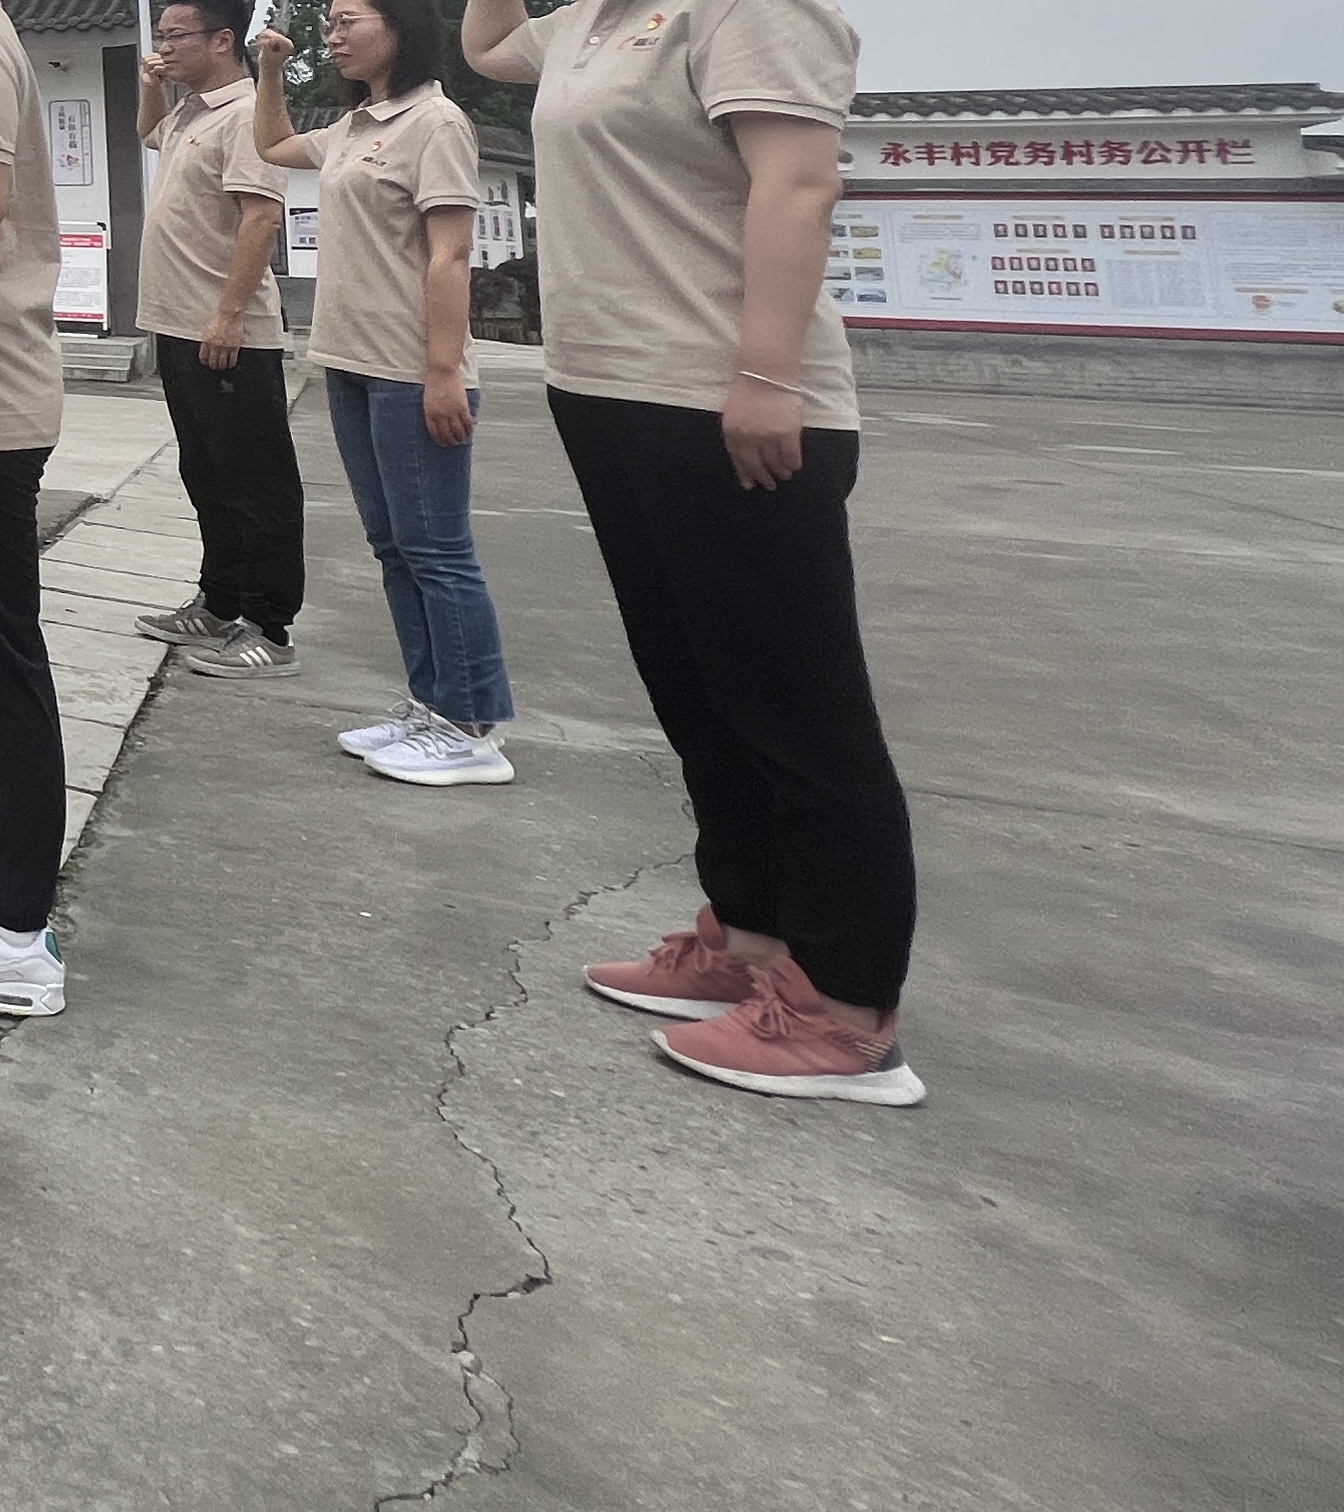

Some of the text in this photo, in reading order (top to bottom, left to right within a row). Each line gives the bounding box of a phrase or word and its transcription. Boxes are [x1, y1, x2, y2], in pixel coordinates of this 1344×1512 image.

[879, 138, 1256, 167] 永丰村党务村务公开栏
